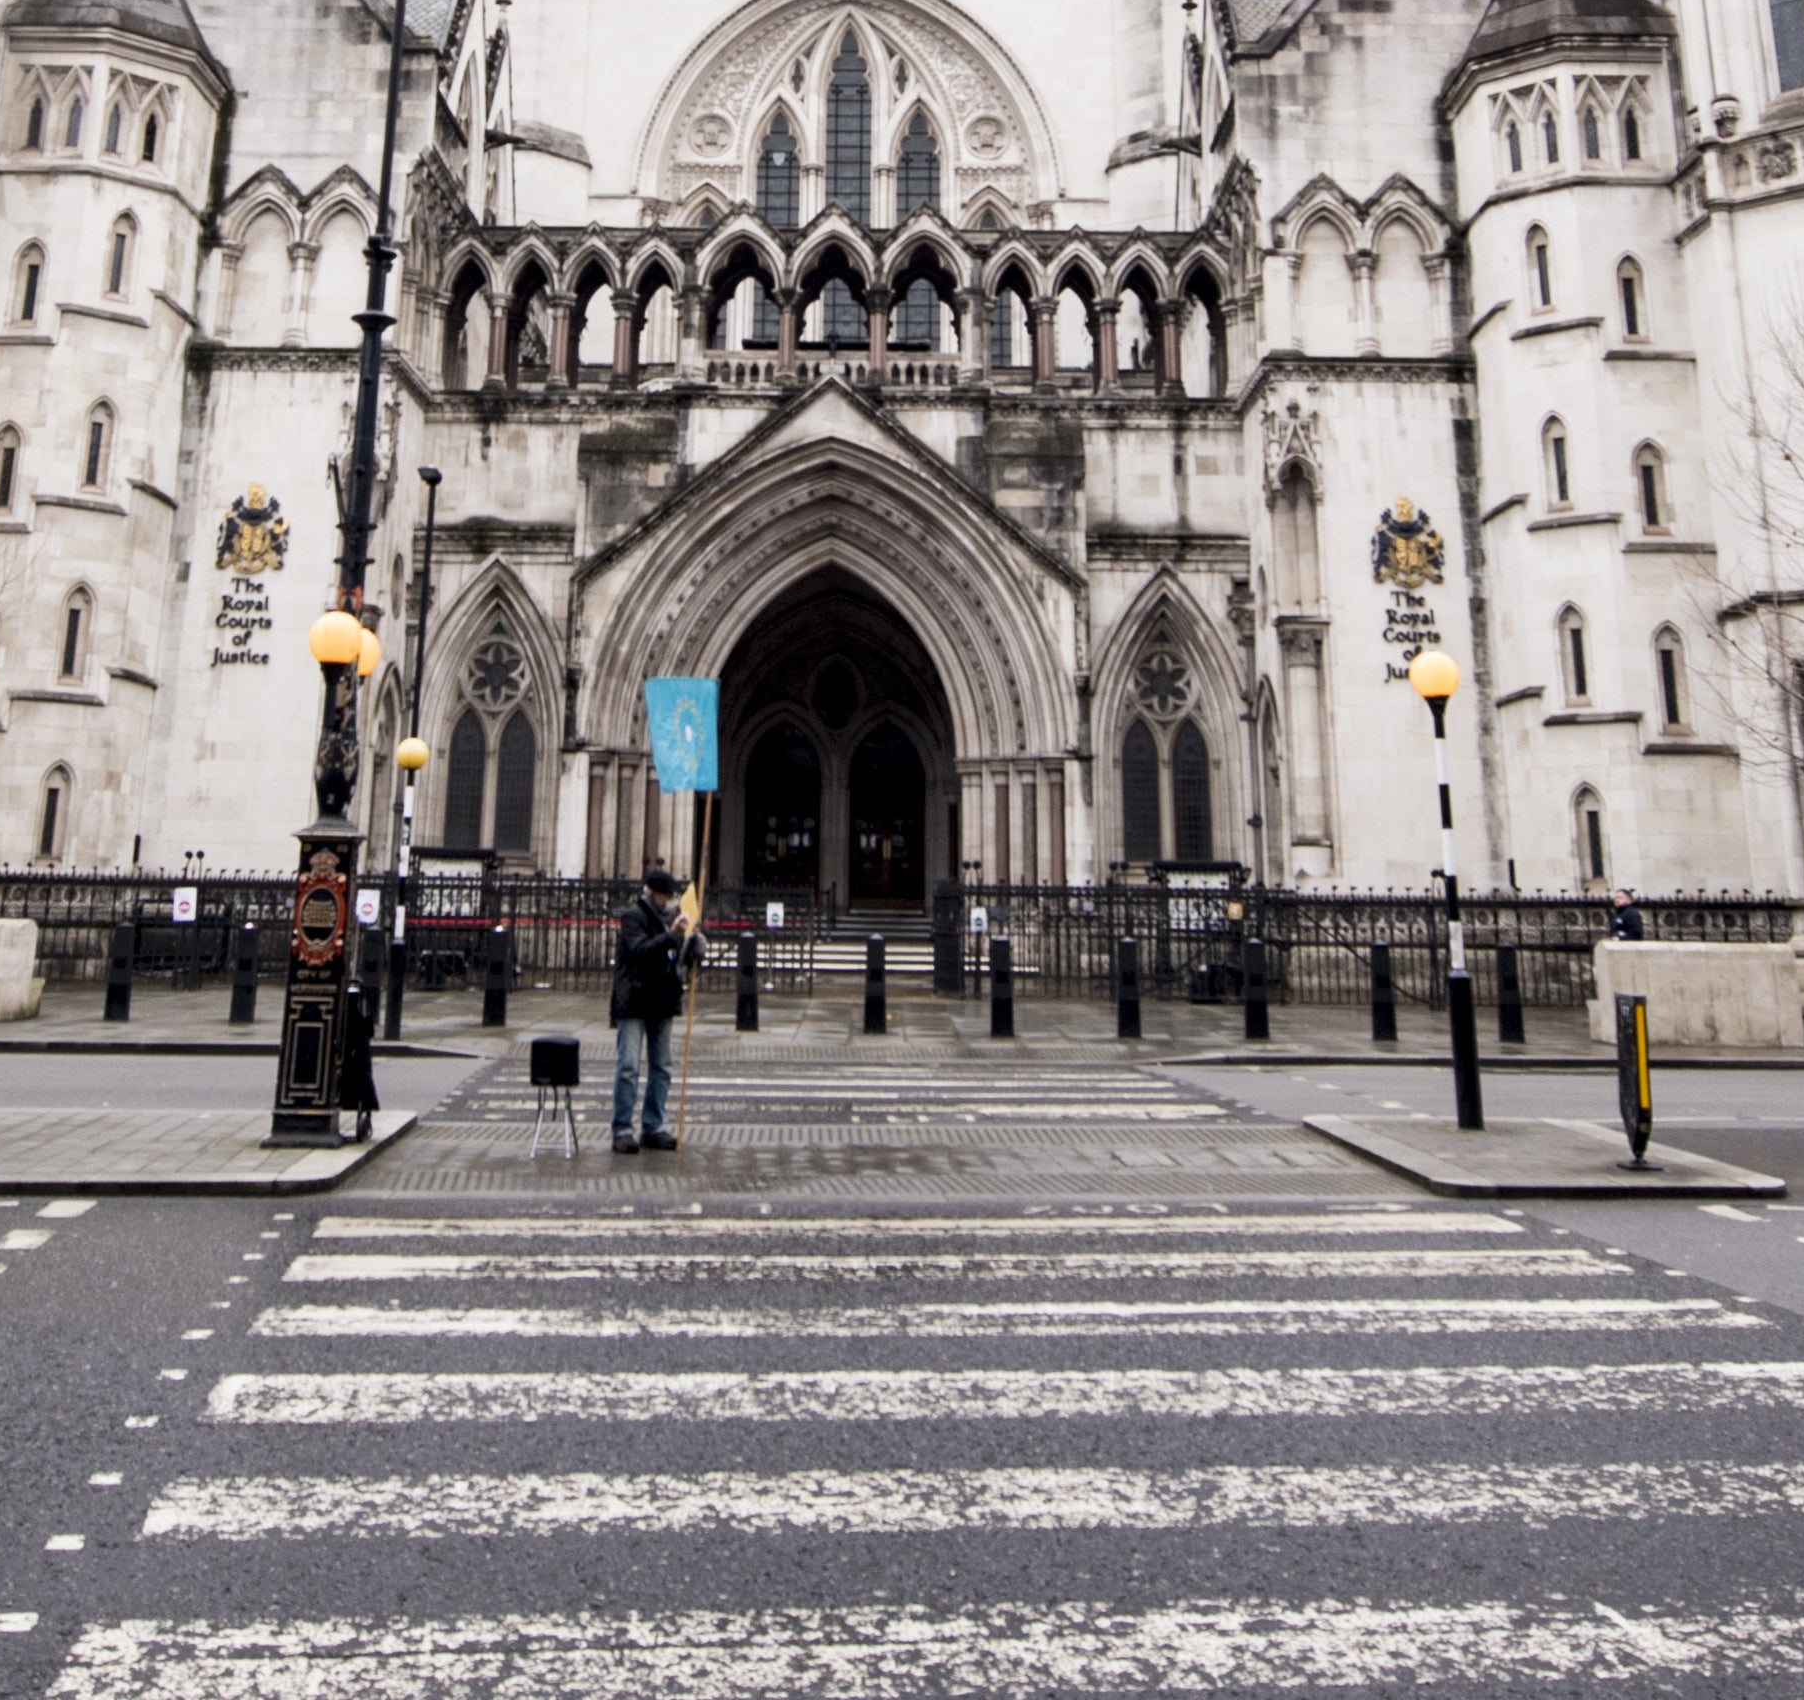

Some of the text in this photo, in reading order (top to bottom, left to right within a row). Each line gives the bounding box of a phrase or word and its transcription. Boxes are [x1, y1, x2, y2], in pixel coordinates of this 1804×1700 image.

[231, 577, 264, 593] The
[221, 595, 269, 613] Royal
[1390, 590, 1425, 607] The
[215, 612, 272, 629] Courts
[1385, 608, 1436, 628] Royal
[232, 630, 252, 646] of
[1383, 627, 1441, 644] Courts
[210, 647, 269, 668] Justice
